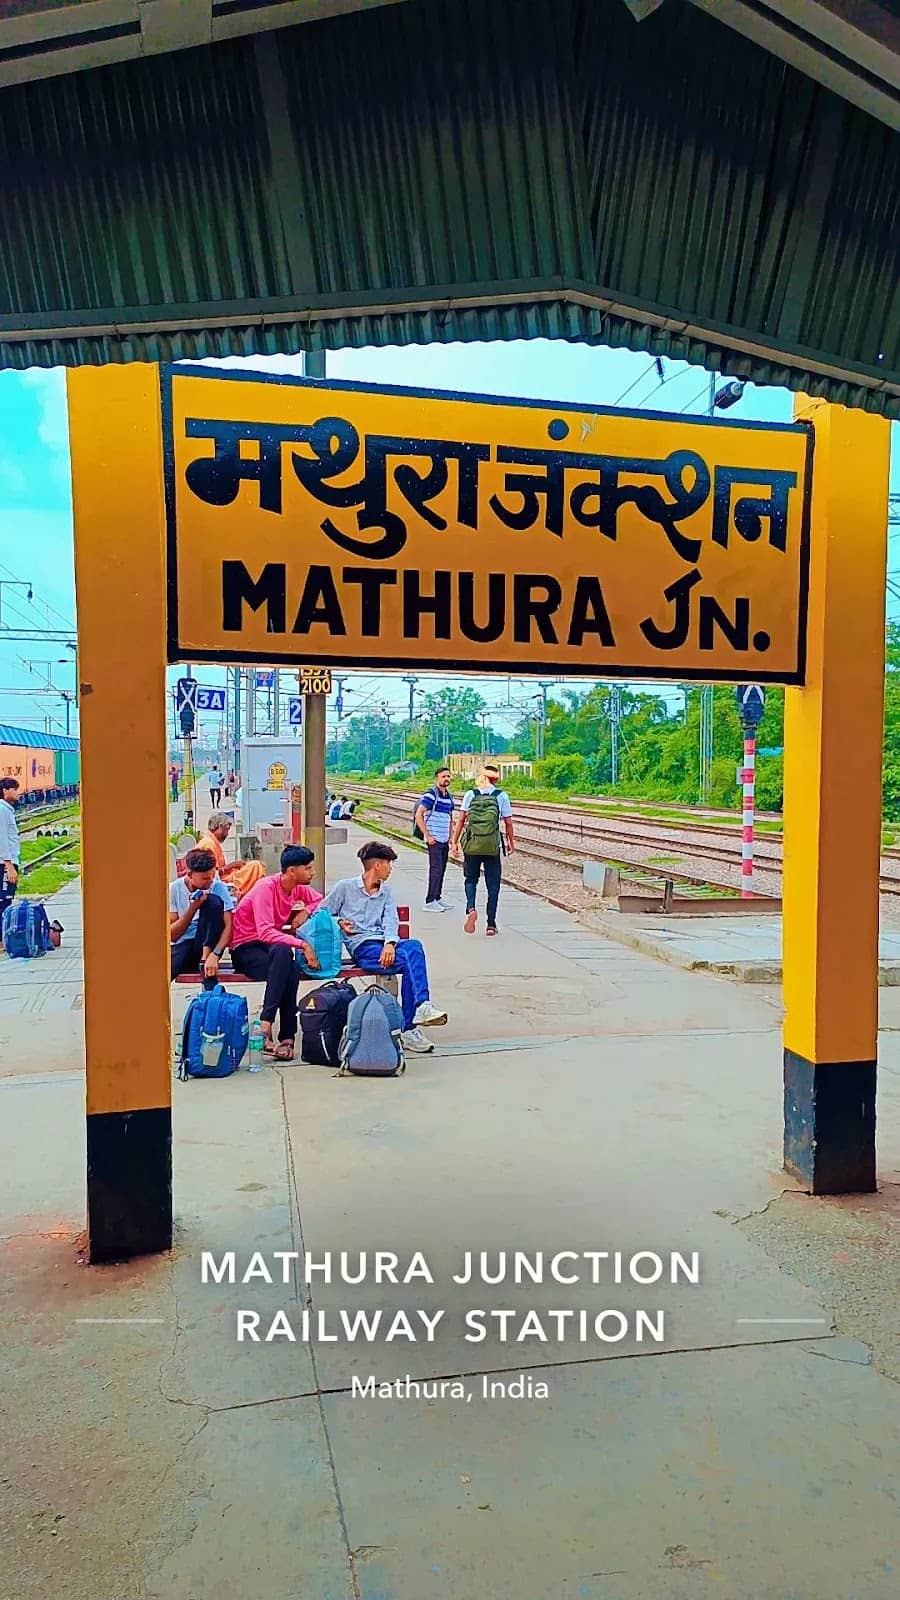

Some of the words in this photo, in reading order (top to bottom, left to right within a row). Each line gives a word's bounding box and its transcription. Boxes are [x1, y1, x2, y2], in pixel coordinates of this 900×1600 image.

[221, 559, 616, 648] MATHURA
[640, 568, 771, 653] JN.
[301, 678, 331, 694] 2100
[198, 692, 223, 709] 3A
[290, 701, 301, 723] 2
